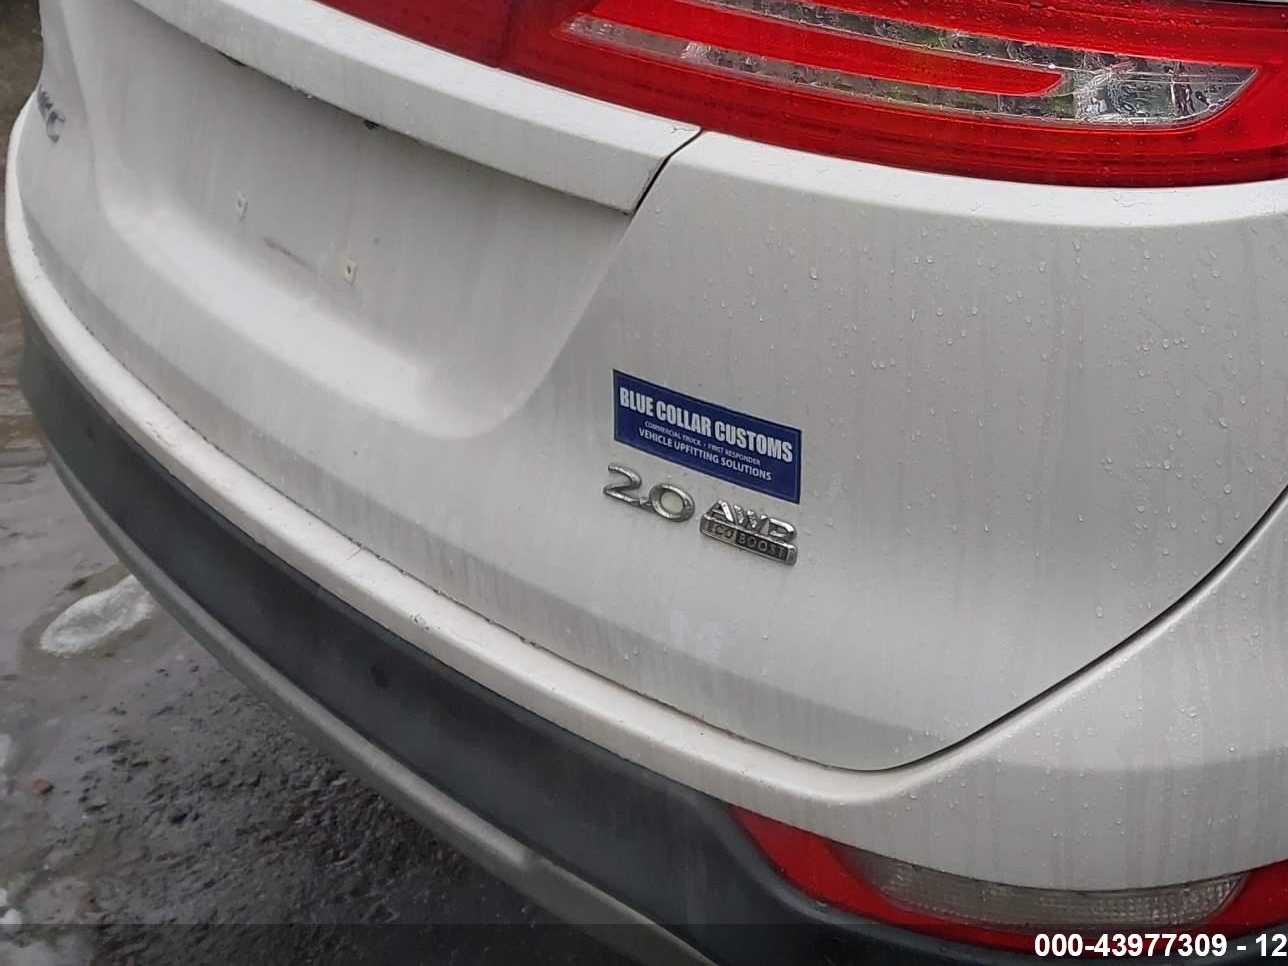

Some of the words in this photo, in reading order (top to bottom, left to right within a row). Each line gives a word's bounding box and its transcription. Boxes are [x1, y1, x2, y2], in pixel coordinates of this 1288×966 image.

[619, 386, 654, 417] BLUE
[656, 400, 711, 436] COLLAR
[714, 421, 793, 463] CUSTOMS
[644, 420, 682, 440] COMMERCIAL
[682, 435, 702, 446] TRUCK
[707, 442, 724, 454] FIRST
[725, 449, 761, 466] RESPONDER
[638, 427, 673, 448] VEHICLE
[673, 441, 720, 464] UPFITTING
[720, 457, 772, 481] SOLUTIONS
[602, 463, 696, 523] 2.0
[706, 499, 798, 543] AWD
